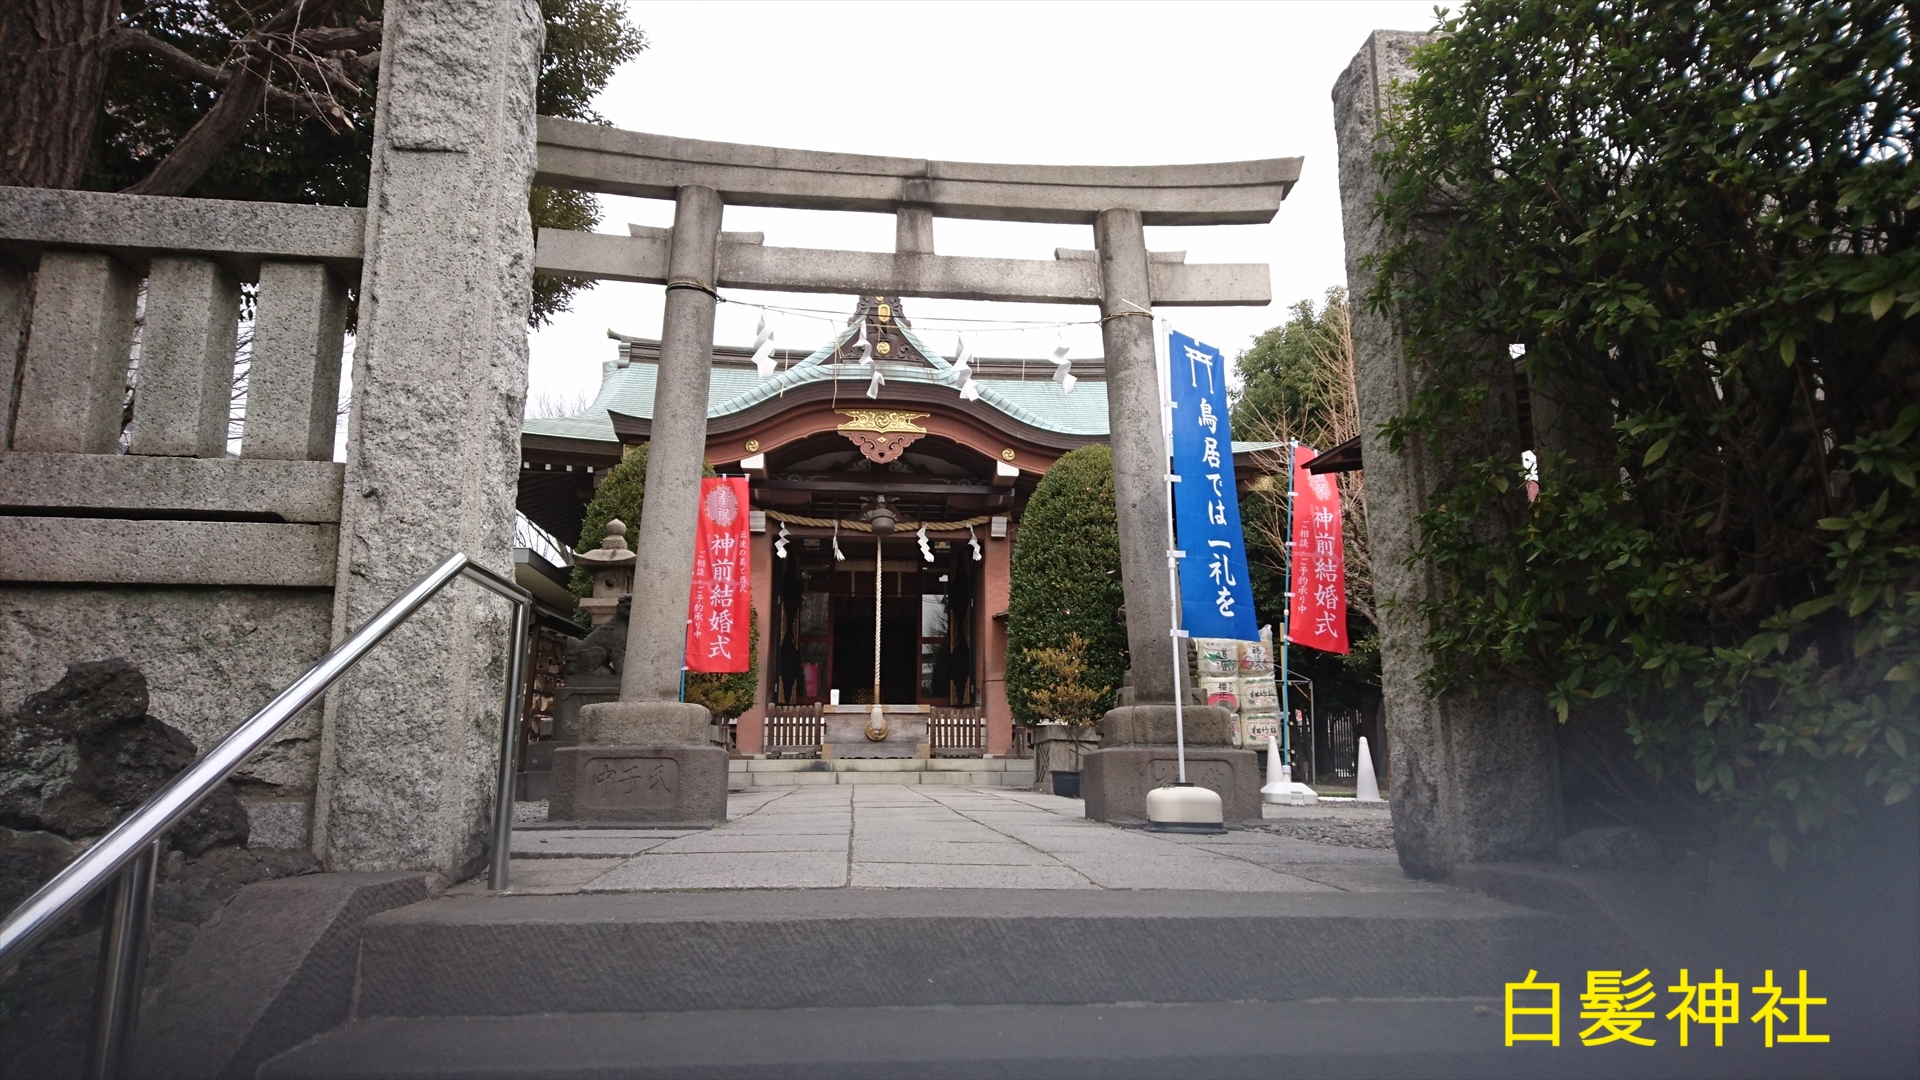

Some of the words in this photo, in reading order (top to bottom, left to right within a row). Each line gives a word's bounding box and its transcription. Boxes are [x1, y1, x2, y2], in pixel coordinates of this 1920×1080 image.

[717, 490, 730, 521] 奉祝
[1198, 398, 1236, 617] 鳥居では一礼を
[708, 532, 735, 660] 神前結婚式
[1313, 505, 1339, 638] 神前結婚式
